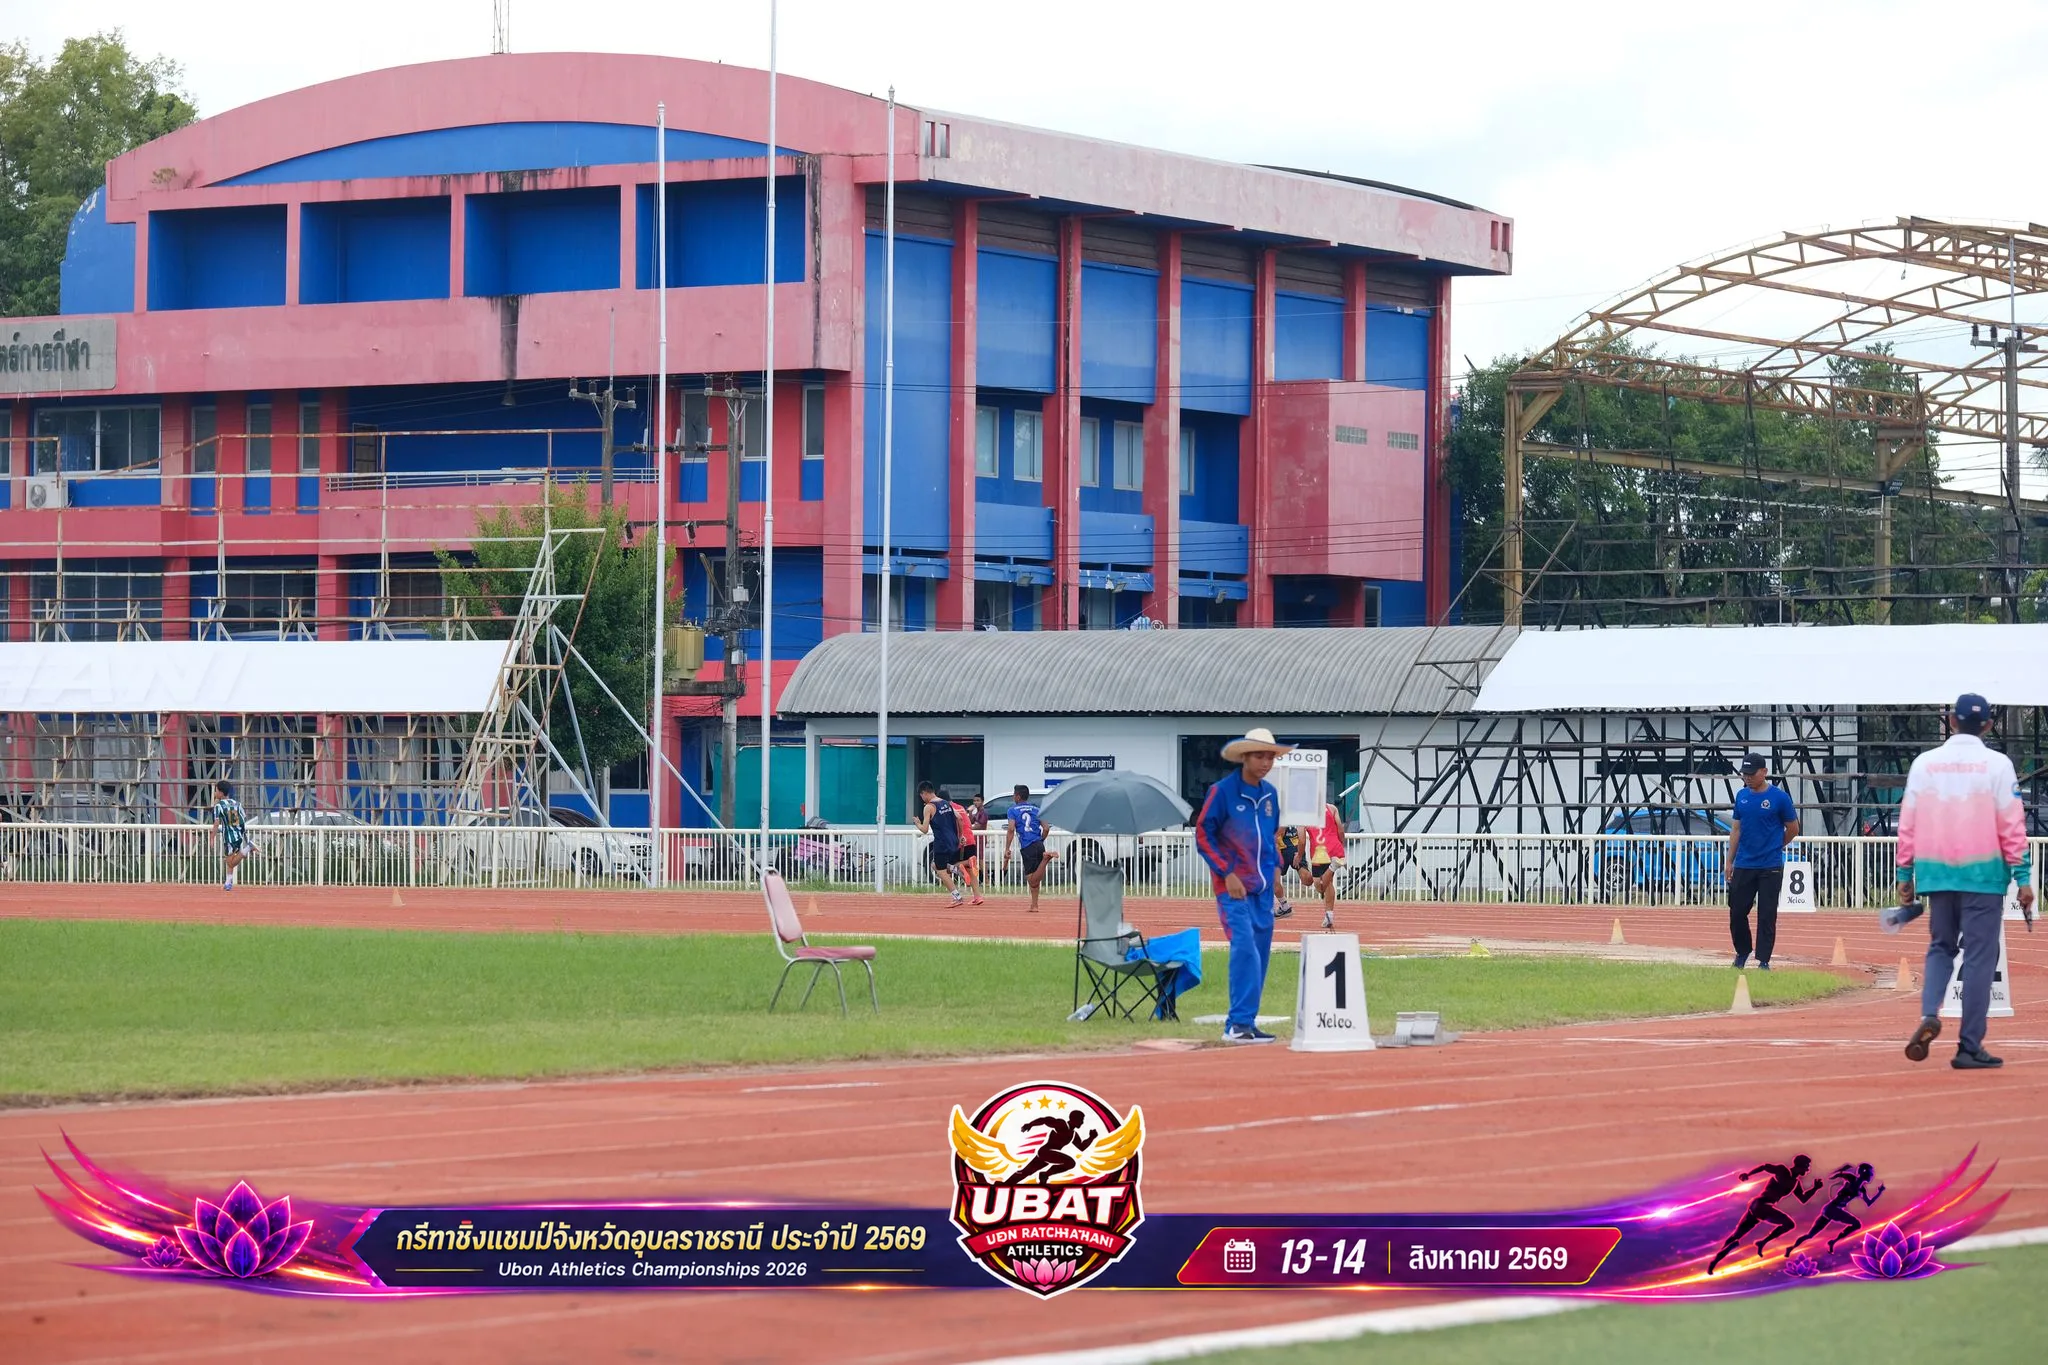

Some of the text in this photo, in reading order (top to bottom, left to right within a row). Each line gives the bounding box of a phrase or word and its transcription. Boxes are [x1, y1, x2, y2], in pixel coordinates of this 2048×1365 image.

[1288, 753, 1302, 762] TO
[1305, 753, 1323, 763] GO
[1022, 812, 1034, 832] 2
[1789, 870, 1805, 895] 8
[1324, 952, 1346, 1009] 1
[1316, 1012, 1353, 1029] Nelco
